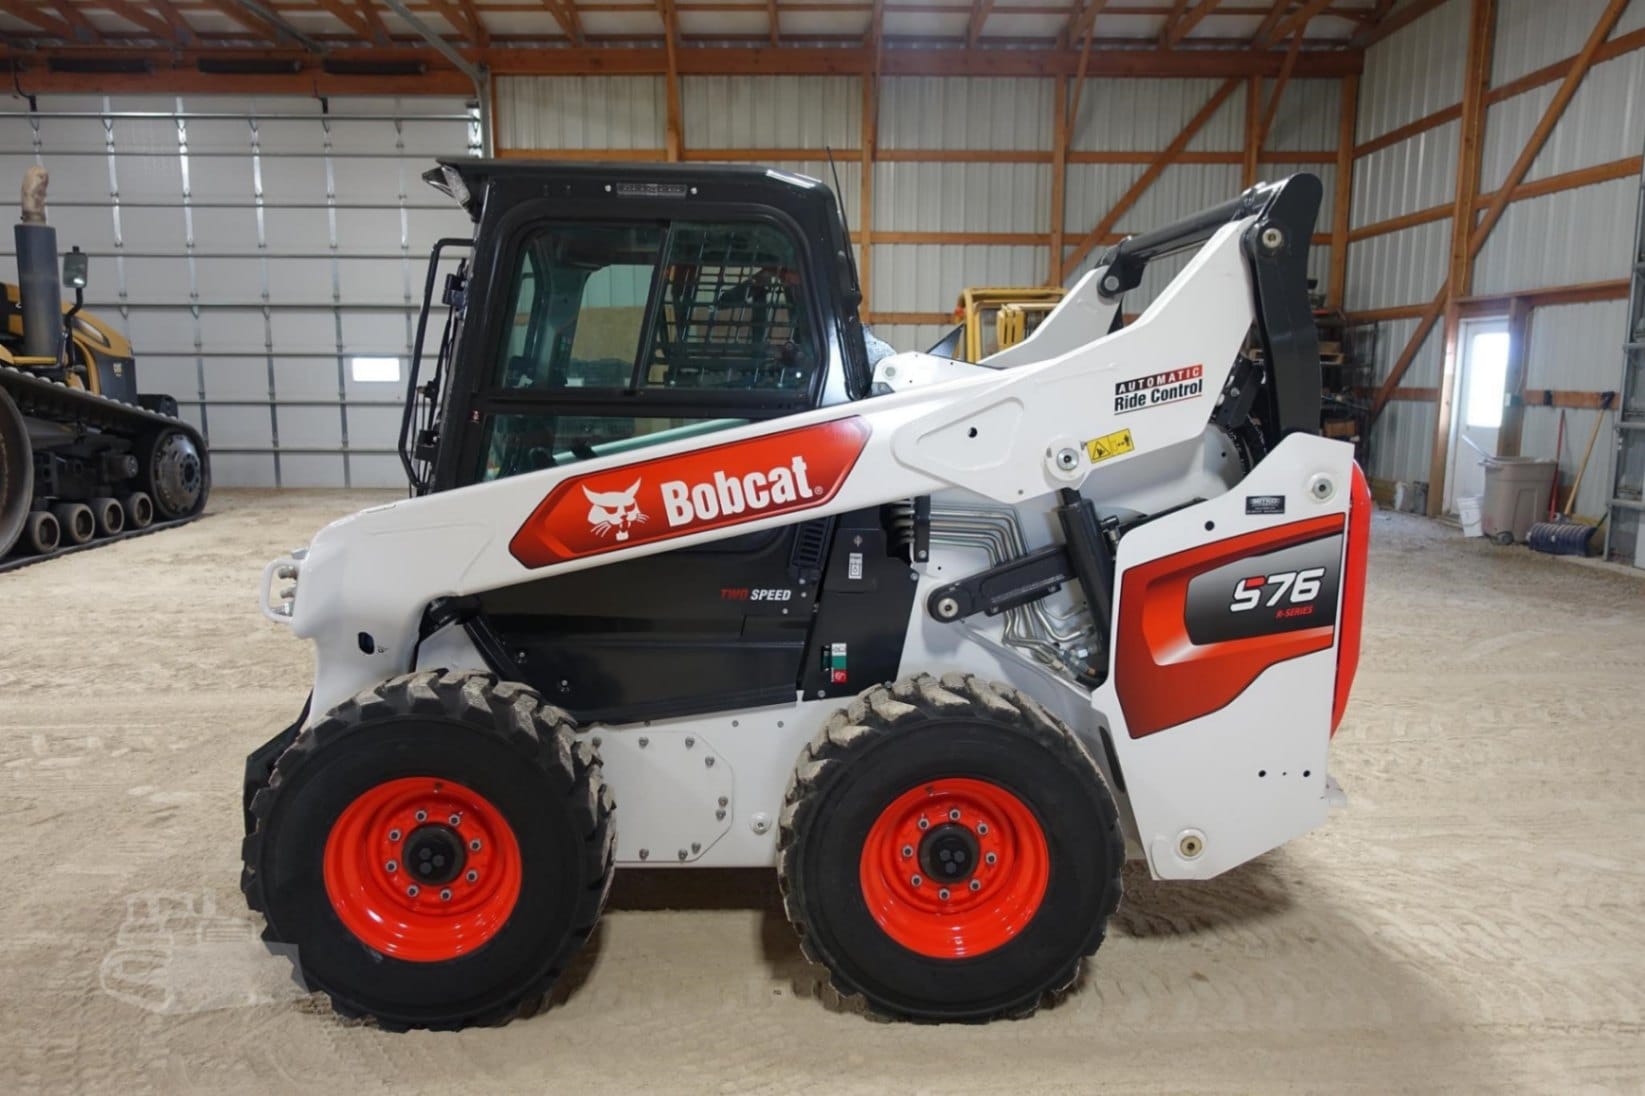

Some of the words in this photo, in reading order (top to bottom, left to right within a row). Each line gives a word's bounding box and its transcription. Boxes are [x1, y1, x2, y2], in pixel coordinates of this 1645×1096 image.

[1114, 393, 1146, 411] Ride
[1151, 379, 1203, 404] Control
[1119, 366, 1200, 394] AUTOMATIC
[660, 455, 813, 527] Bobcat
[719, 588, 749, 600] TWO
[750, 589, 792, 601] SPEED
[1230, 567, 1325, 612] S76
[1275, 605, 1314, 619] R-SERIES
